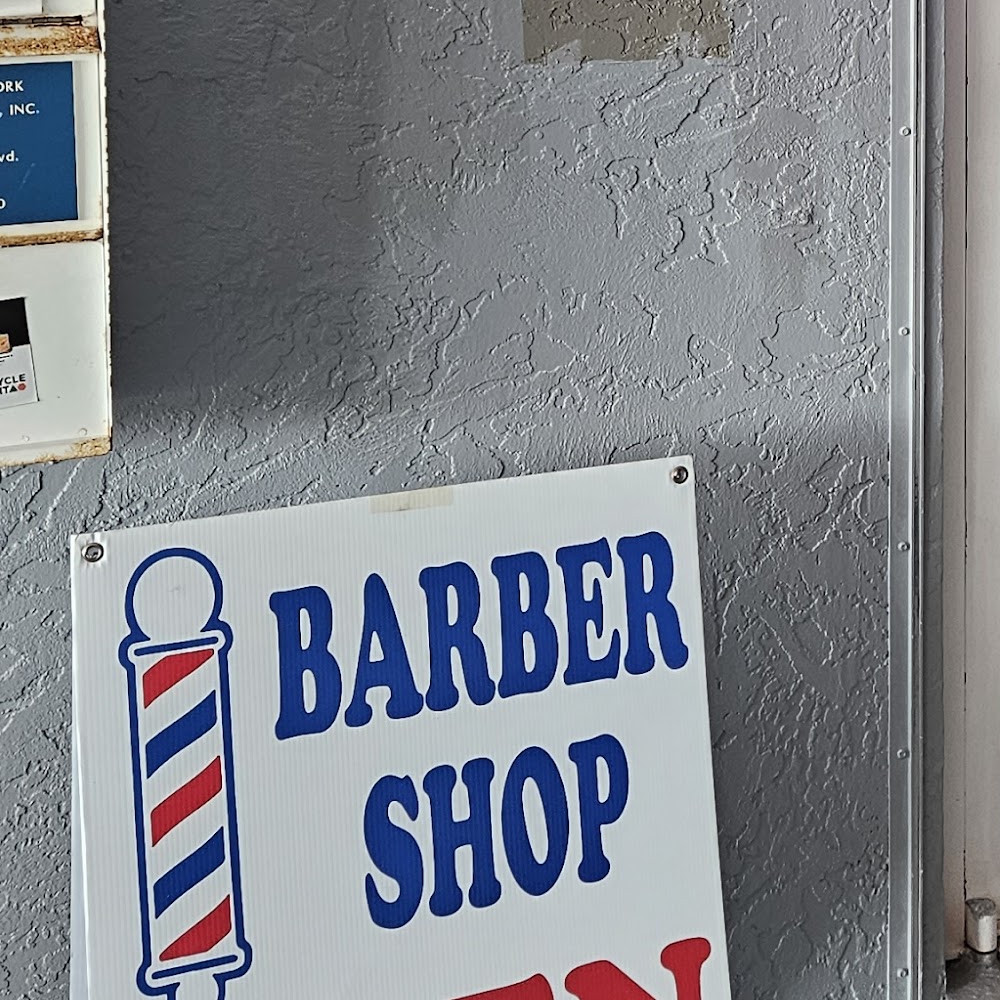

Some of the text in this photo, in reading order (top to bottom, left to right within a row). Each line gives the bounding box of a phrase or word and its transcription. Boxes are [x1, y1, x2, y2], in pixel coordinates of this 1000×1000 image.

[9, 103, 40, 116] INC.
[268, 531, 689, 740] BARBER
[363, 733, 629, 929] SHOP
